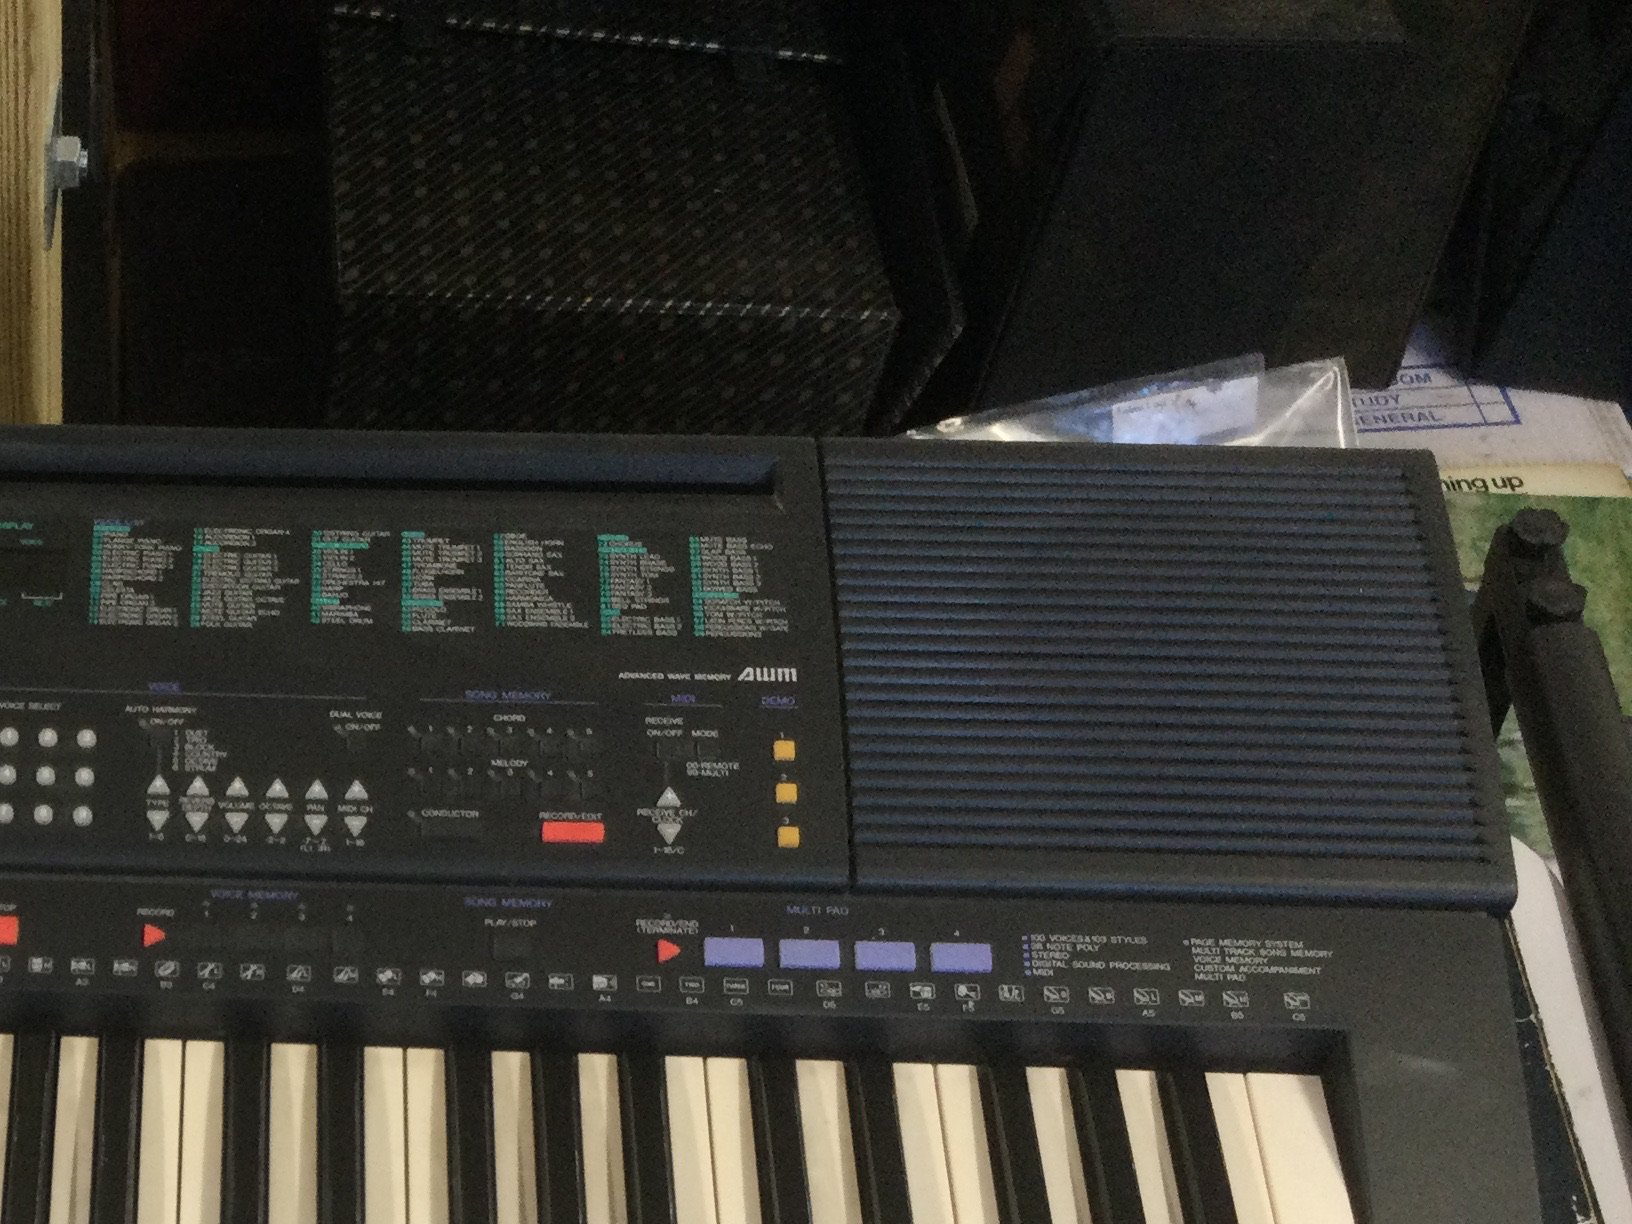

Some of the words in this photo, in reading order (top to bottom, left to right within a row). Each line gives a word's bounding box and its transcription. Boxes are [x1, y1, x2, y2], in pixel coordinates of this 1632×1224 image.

[1356, 411, 1442, 425] ENERAL
[1491, 476, 1523, 491] up
[618, 671, 664, 680] ADVANCED
[738, 667, 798, 682] AWM
[465, 690, 497, 700] SONG
[501, 691, 552, 701] MEMORY
[761, 696, 795, 706] DEMO
[0, 702, 25, 710] VOICE
[28, 702, 62, 711] SELECT
[125, 705, 149, 713] AUTO
[152, 706, 197, 714] HARMONY
[329, 710, 353, 718] DUAL
[356, 711, 382, 719] VOICE
[493, 713, 526, 722] CHORD
[645, 717, 684, 726] RECEIVE
[646, 729, 683, 738] ON/OFF
[491, 759, 528, 768] MELODY
[421, 809, 479, 818] CONDUCTOR
[539, 812, 602, 820] RECORD/EDIT
[637, 808, 679, 817] RECEIVE
[500, 899, 554, 908] MEMORY
[786, 905, 822, 915] MULTI
[826, 906, 849, 916] PAD
[484, 918, 537, 928] PLAY/STOP
[636, 919, 699, 928] RECORD/END
[1077, 944, 1101, 952] POLY
[1191, 938, 1216, 946] PAGE
[1218, 939, 1262, 947] MEMORY
[1264, 940, 1304, 949] SYSTEM
[1224, 948, 1255, 956] TRACK
[1259, 949, 1288, 957] SONG
[1290, 950, 1333, 958] MEMORY
[1032, 960, 1068, 968] DIGITAL
[1072, 961, 1105, 969] SOUND
[1109, 962, 1171, 970] PROCESSING
[1193, 956, 1222, 964] VOICE
[1225, 956, 1268, 965] MEMORY
[1033, 969, 1054, 977] MIDI
[1194, 964, 1235, 973] CUSTOM
[1239, 966, 1322, 975] ACCOMPANIMENT
[1194, 973, 1223, 981] MULTI
[1227, 974, 1247, 982] PAD
